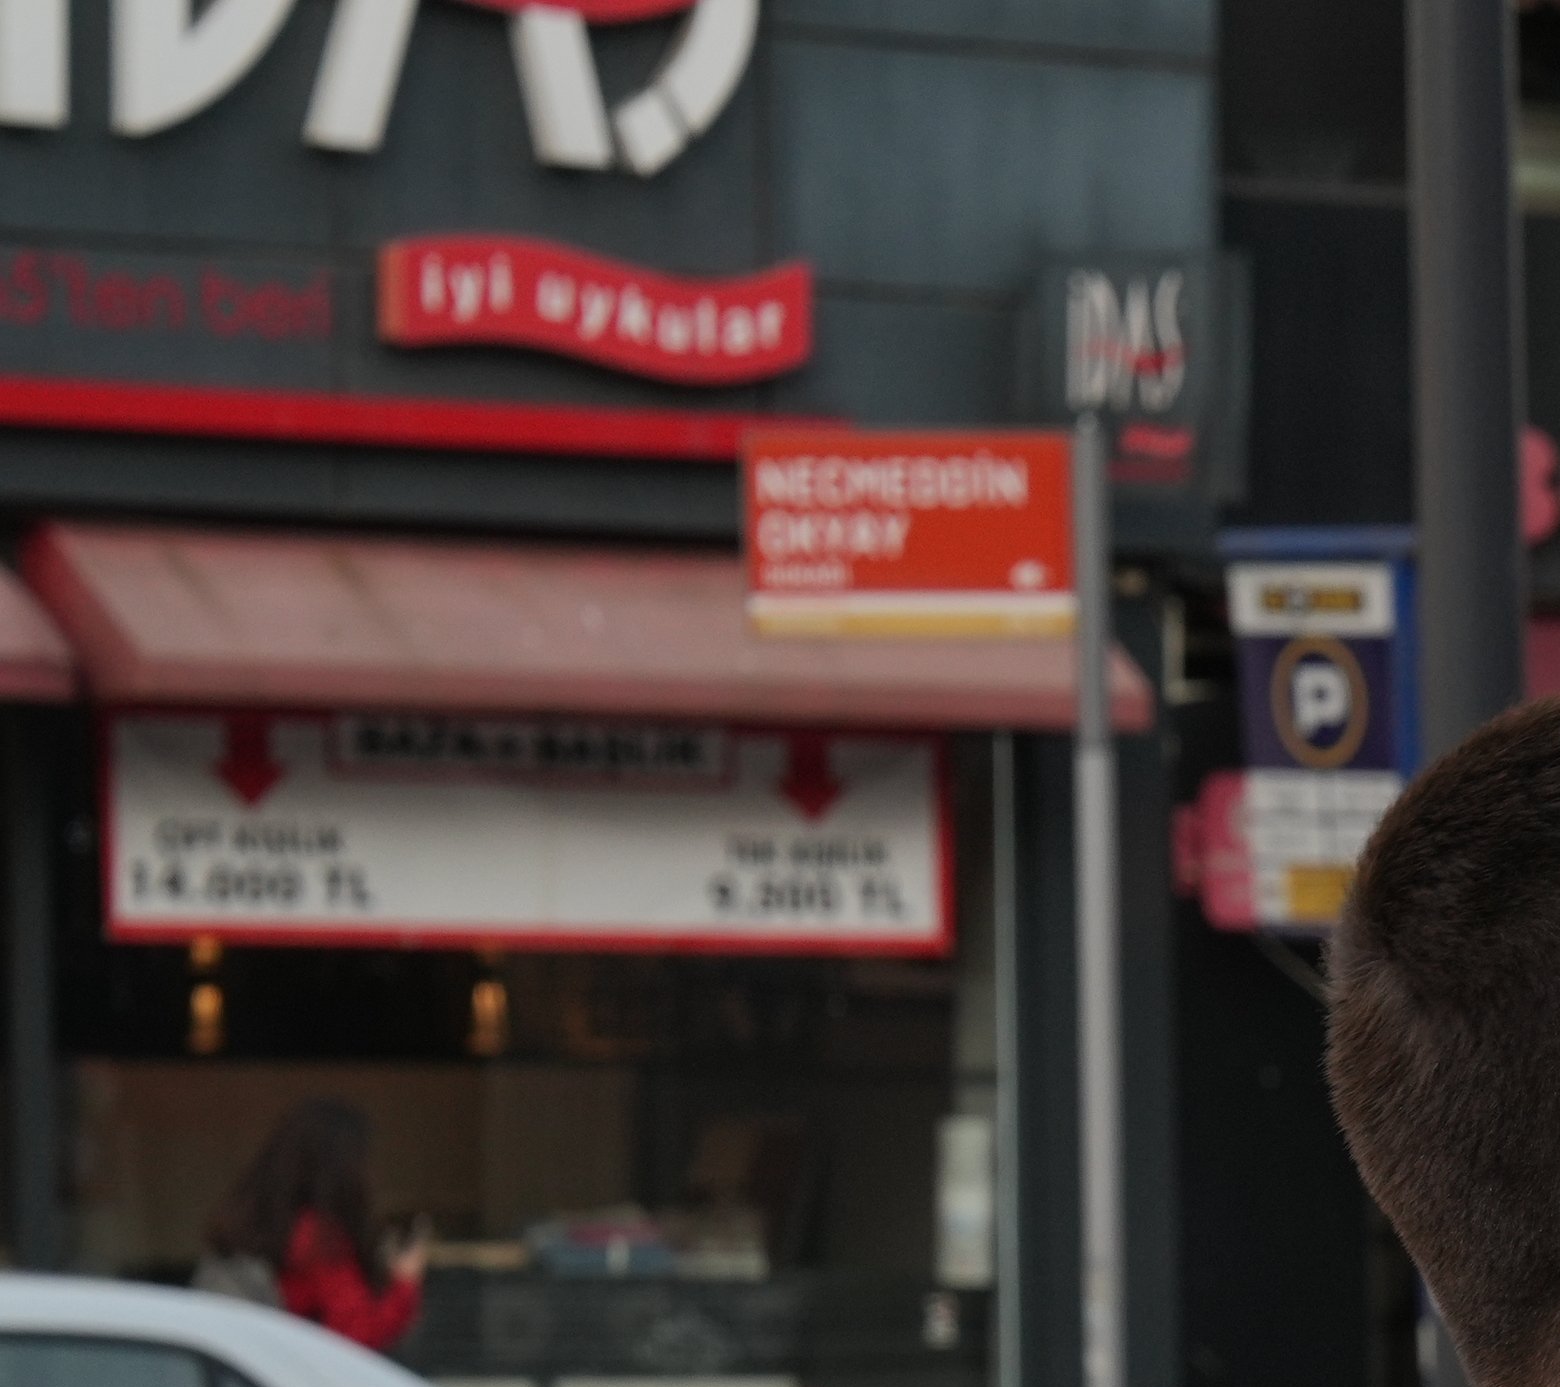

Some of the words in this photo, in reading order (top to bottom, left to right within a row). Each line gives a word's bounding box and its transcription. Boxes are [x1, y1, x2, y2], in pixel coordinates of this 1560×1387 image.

[420, 250, 514, 325] iyi
[536, 270, 786, 358] uykular
[757, 451, 1028, 506] NECMEDDİN
[322, 864, 374, 910] TL
